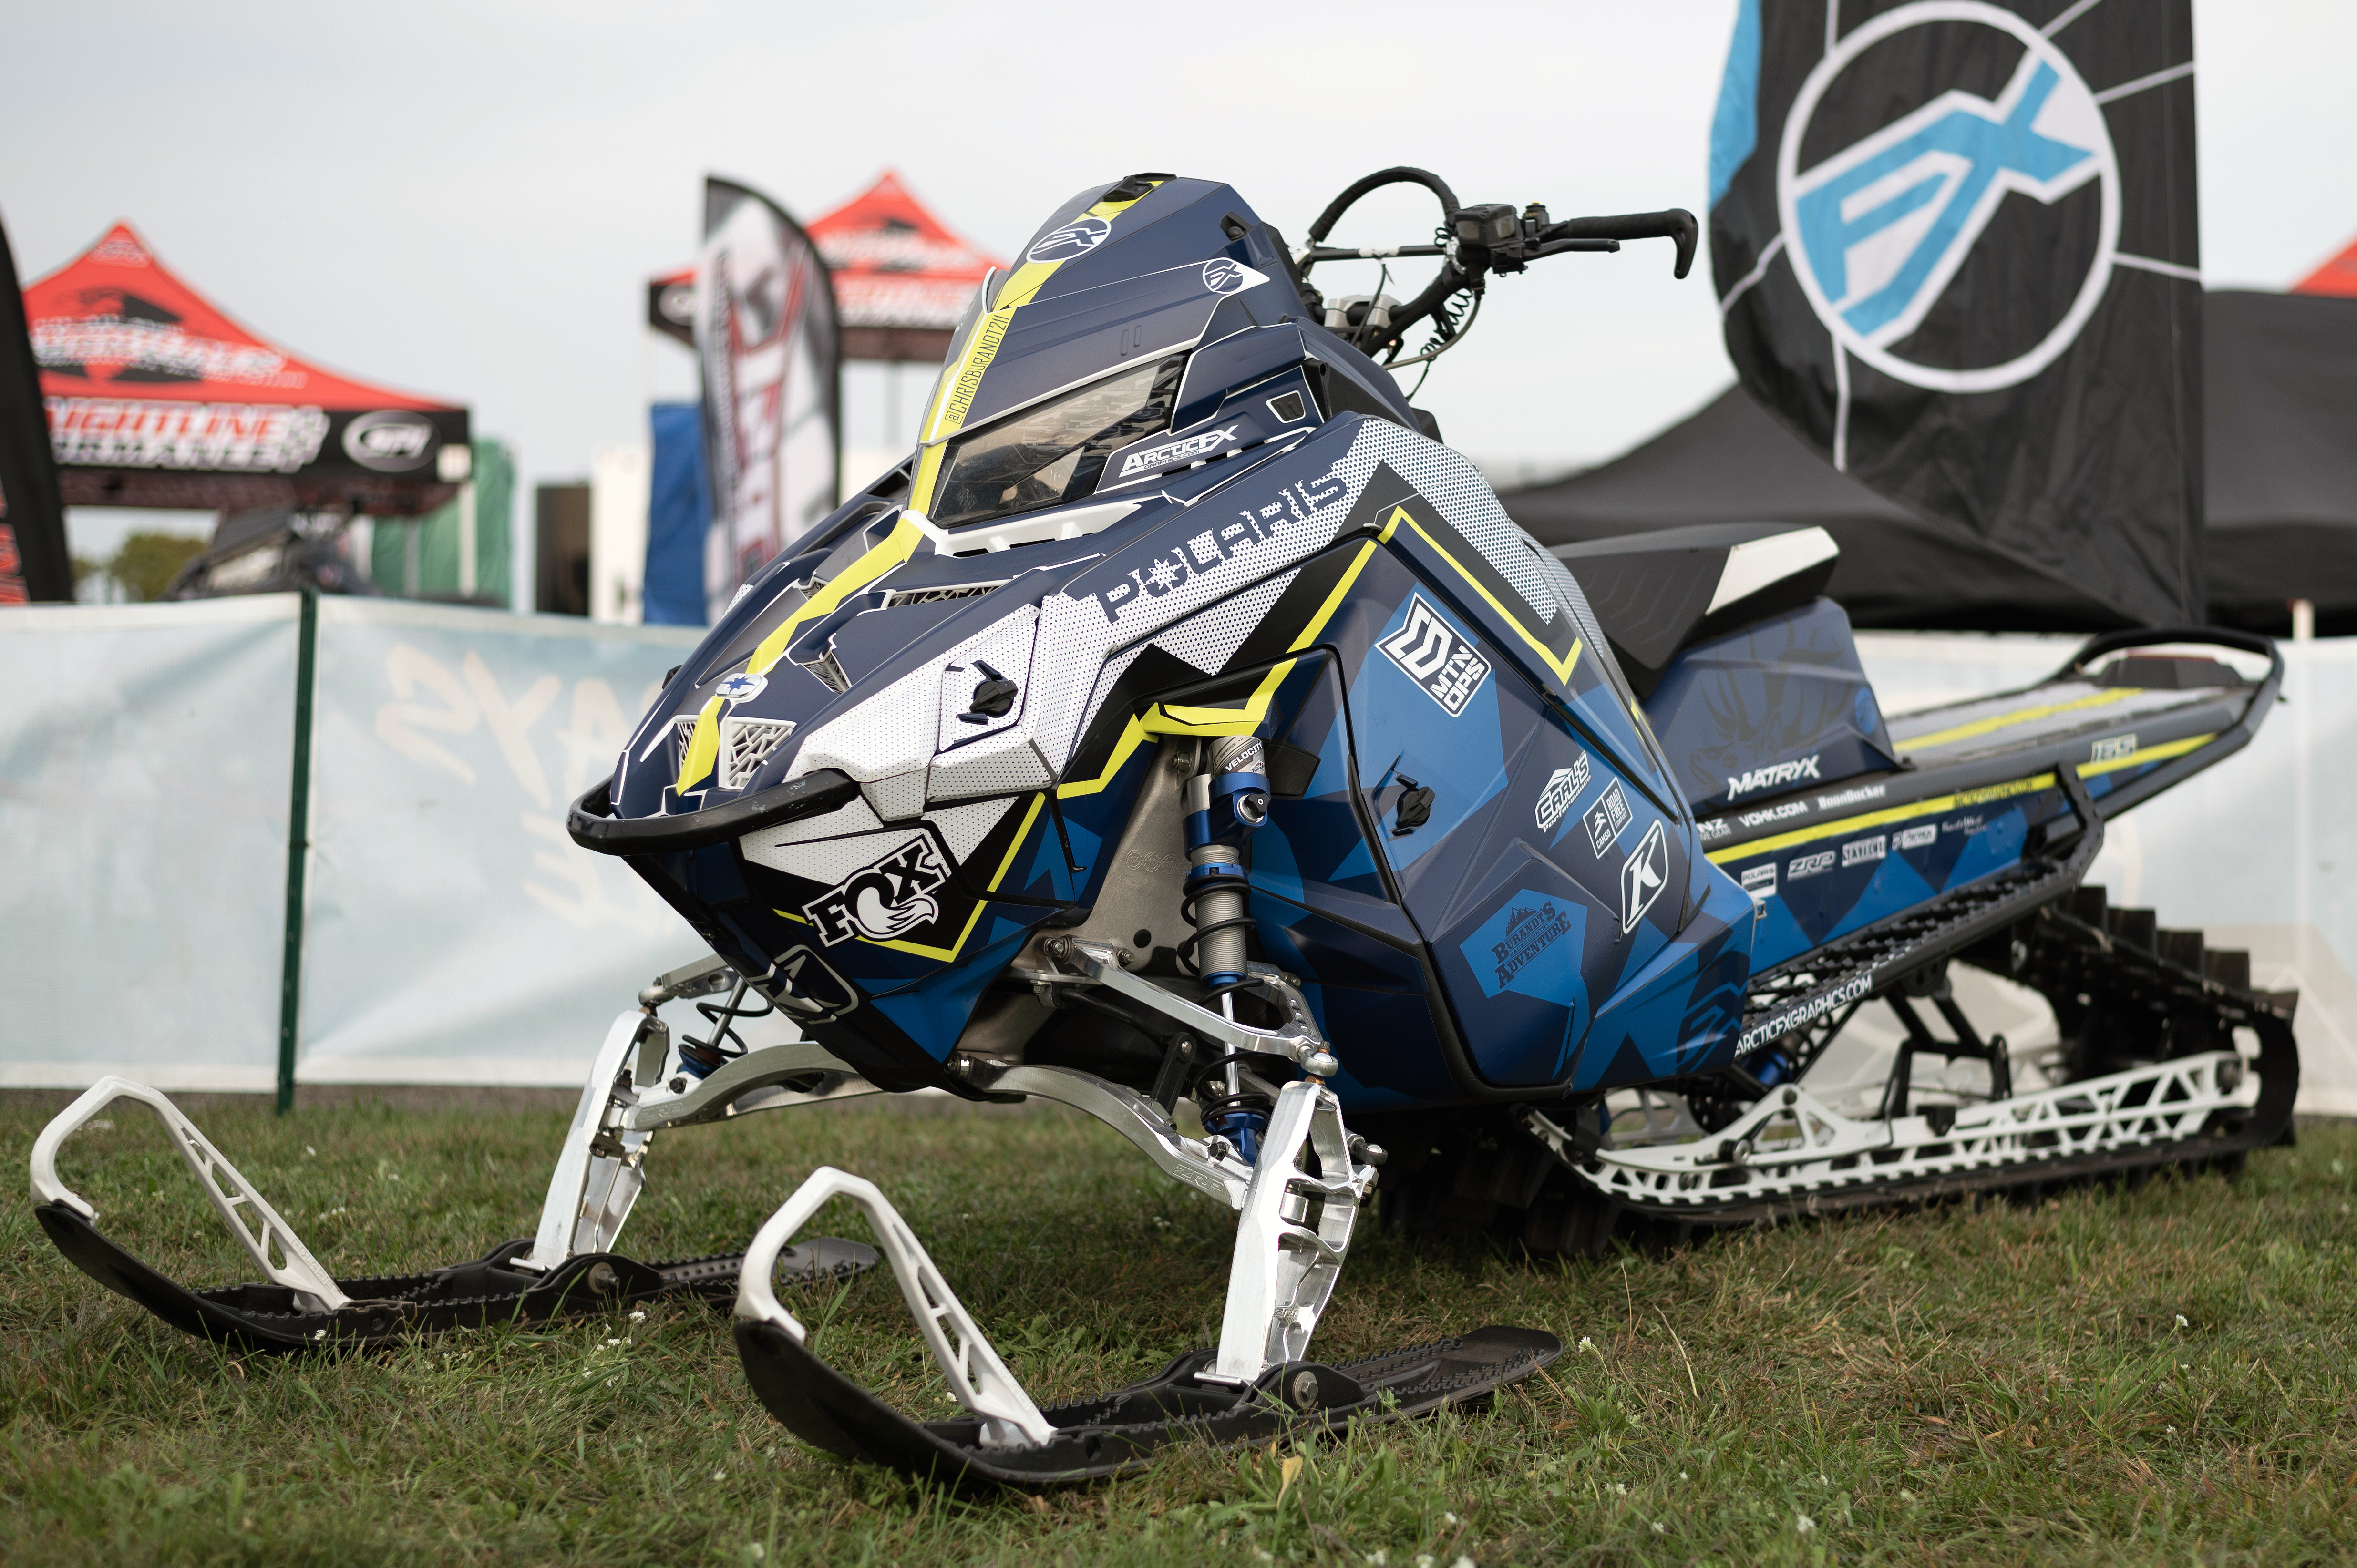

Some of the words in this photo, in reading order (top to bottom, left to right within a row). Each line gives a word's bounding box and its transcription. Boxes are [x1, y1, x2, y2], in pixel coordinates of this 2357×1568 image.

[945, 315, 1009, 424] @CHRISBURANDT211
[1094, 476, 1348, 624] POLARIS
[1430, 645, 1473, 699] MTN
[1443, 657, 1485, 711] OPS
[1225, 740, 1263, 771] VELOCITY
[1727, 753, 1821, 801] MATRYX
[1606, 788, 1621, 811] ROAD
[1610, 799, 1626, 822] FREE
[1614, 810, 1627, 829] COMPANY
[1595, 828, 1611, 850] CAMSO
[804, 840, 944, 945] FOX
[1491, 901, 1555, 964] BURANDT'S
[1494, 910, 1572, 989] ADVENTURE
[1173, 1164, 1224, 1191] ZRP
